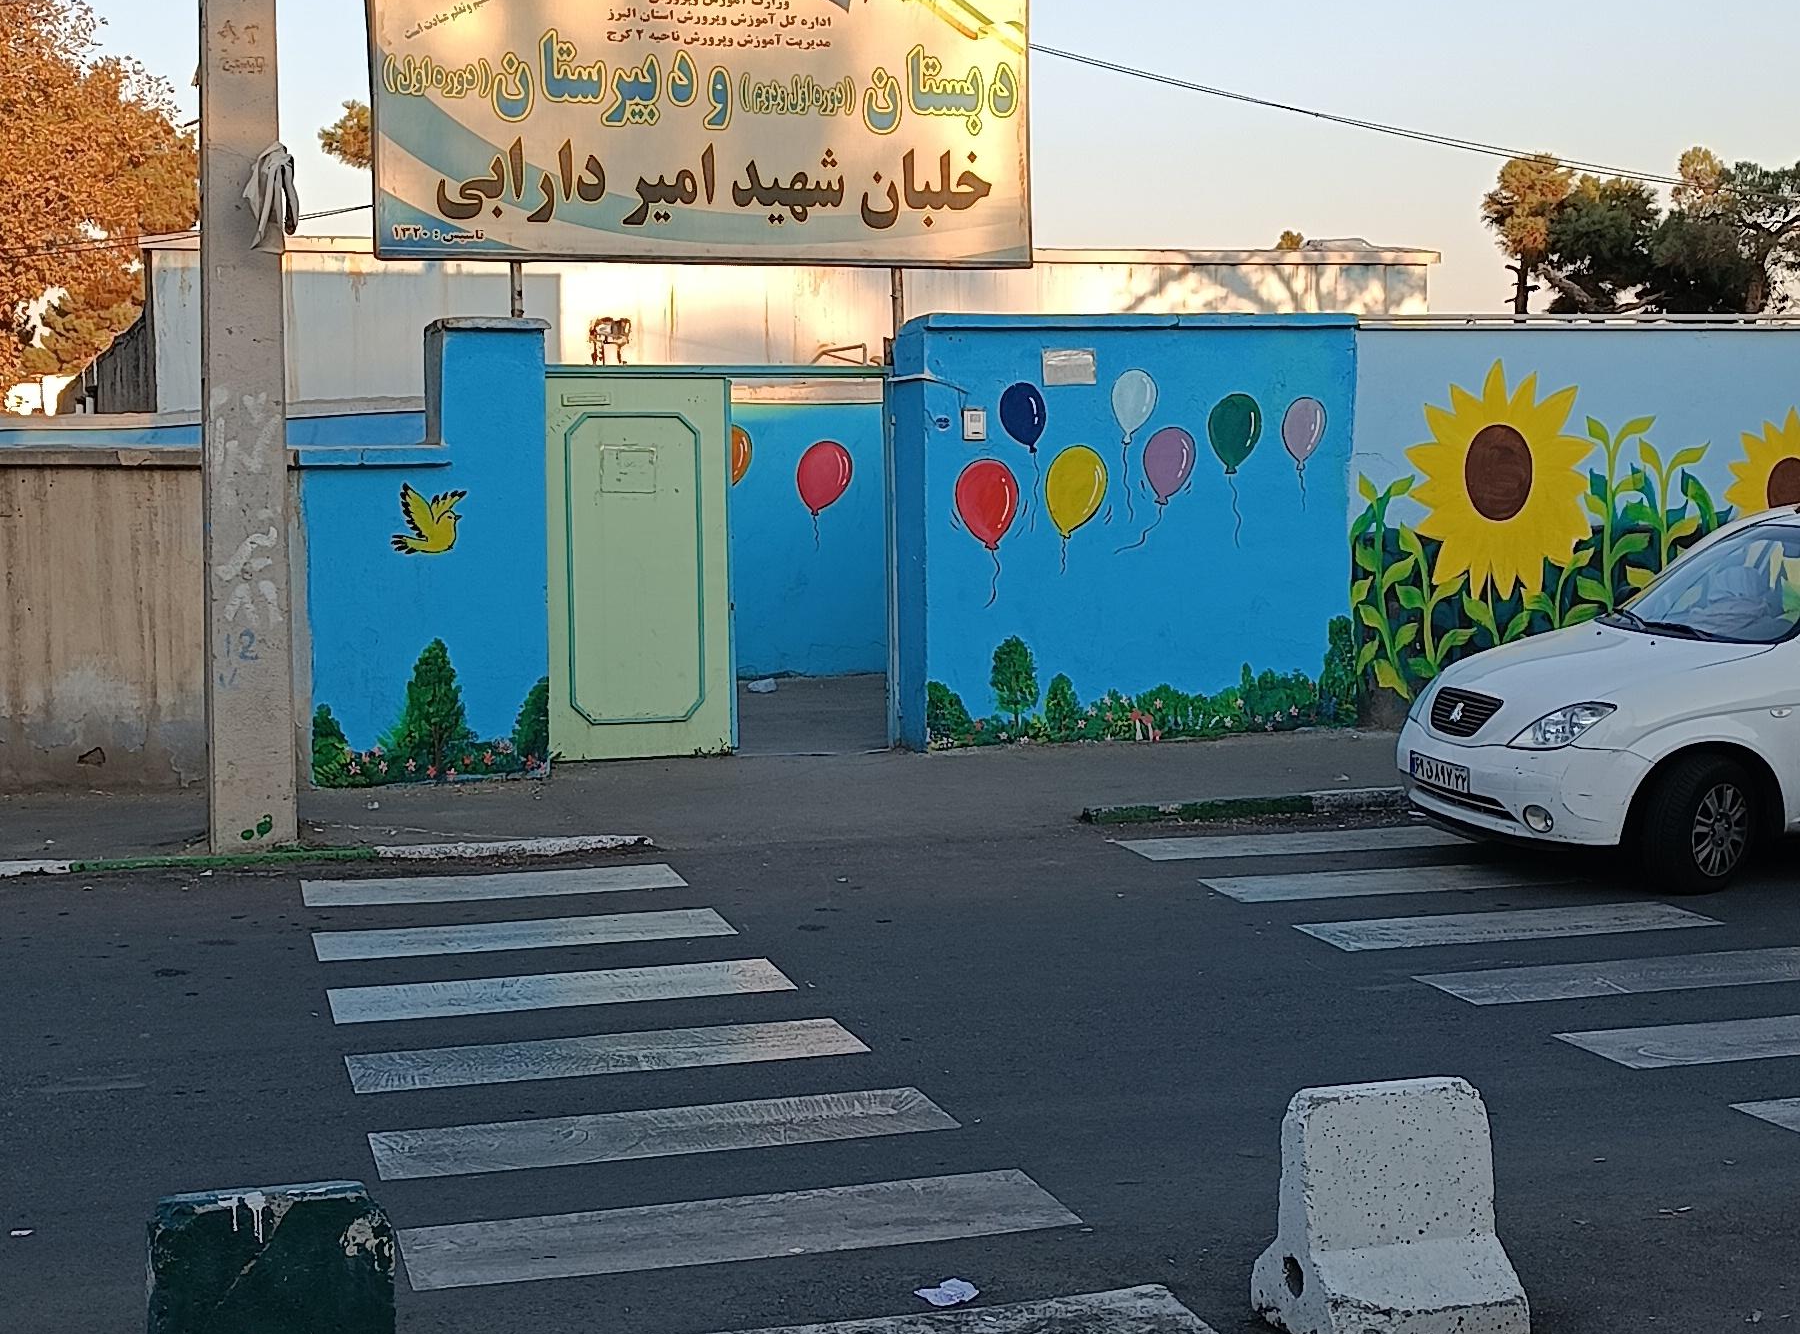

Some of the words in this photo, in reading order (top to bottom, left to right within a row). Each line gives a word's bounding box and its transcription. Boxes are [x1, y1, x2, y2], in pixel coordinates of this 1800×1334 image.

[606, 7, 637, 21] البرز
[639, 8, 674, 22] استان
[730, 12, 776, 28] آموزش
[779, 14, 798, 28] کل
[800, 16, 832, 29] اداره
[606, 28, 633, 42] کرج
[648, 30, 681, 43] ناحیه
[736, 33, 783, 48] آموزش
[785, 37, 831, 50] مدیریت
[702, 65, 733, 130] و
[436, 135, 607, 224] دارابی
[621, 142, 716, 226] امیر
[731, 147, 846, 224] شهید
[860, 147, 993, 229] خلبان
